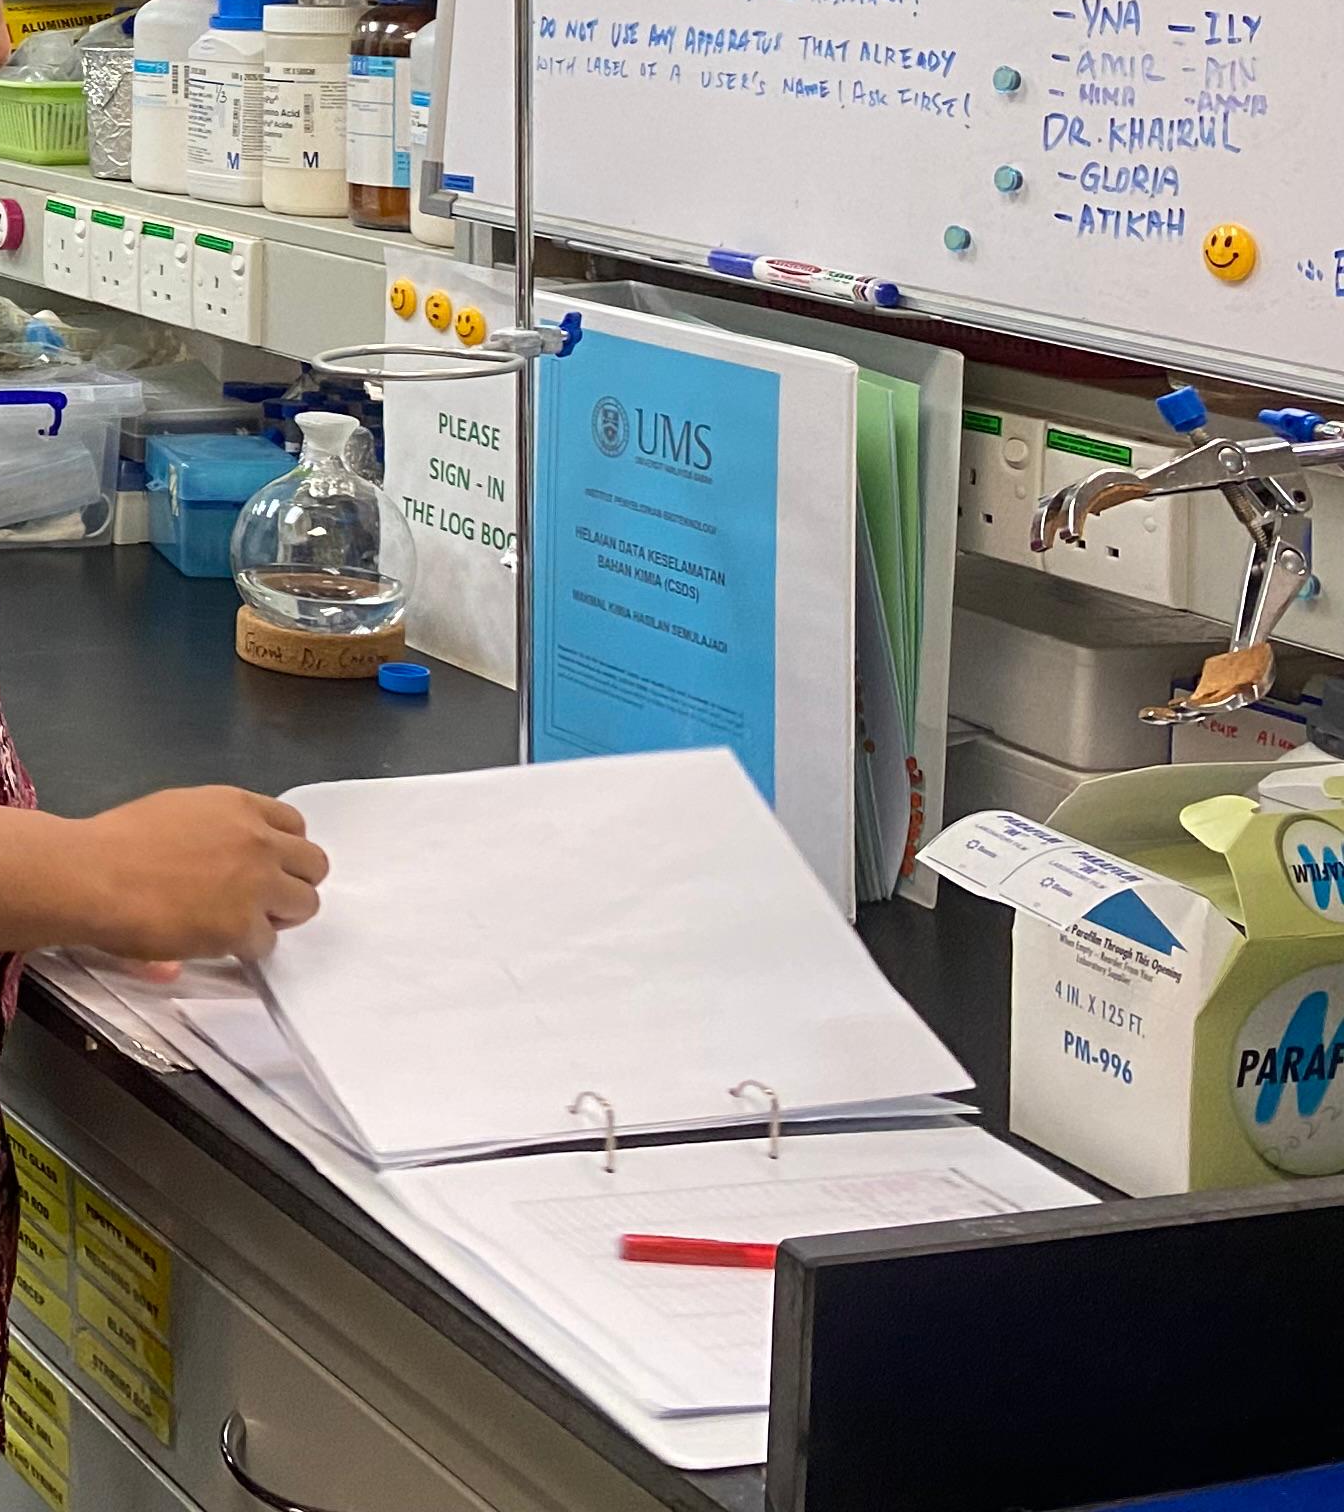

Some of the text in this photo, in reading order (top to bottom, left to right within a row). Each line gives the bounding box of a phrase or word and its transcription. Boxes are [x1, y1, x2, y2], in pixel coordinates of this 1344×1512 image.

[536, 56, 576, 76] WITH
[586, 56, 629, 79] LABEL
[670, 64, 681, 84] A
[540, 16, 556, 38] DO
[566, 18, 599, 41] NOT
[611, 22, 640, 48] USE
[798, 35, 850, 62] THAT
[860, 42, 956, 78] ALREADY
[439, 412, 500, 451] PLEASE
[635, 408, 712, 470] UMS
[429, 457, 471, 491] SIGN
[487, 475, 504, 502] IN
[402, 496, 475, 540] THE LOG
[575, 525, 725, 586] HELAIAN DATA KESELAMATAN
[598, 554, 699, 604] BAHAN KIMIA (CSDS)
[997, 816, 1064, 843] PARAFILM
[1072, 851, 1143, 882] PARAFILM
[1071, 924, 1102, 945] Parafilm
[1103, 934, 1133, 960] Through
[1135, 951, 1150, 967] This
[1152, 959, 1182, 984] Opening
[1055, 980, 1145, 1039] 4 IN. X 125 FT.
[1064, 1030, 1132, 1084] PM-996
[18, 1230, 45, 1260] ATULA
